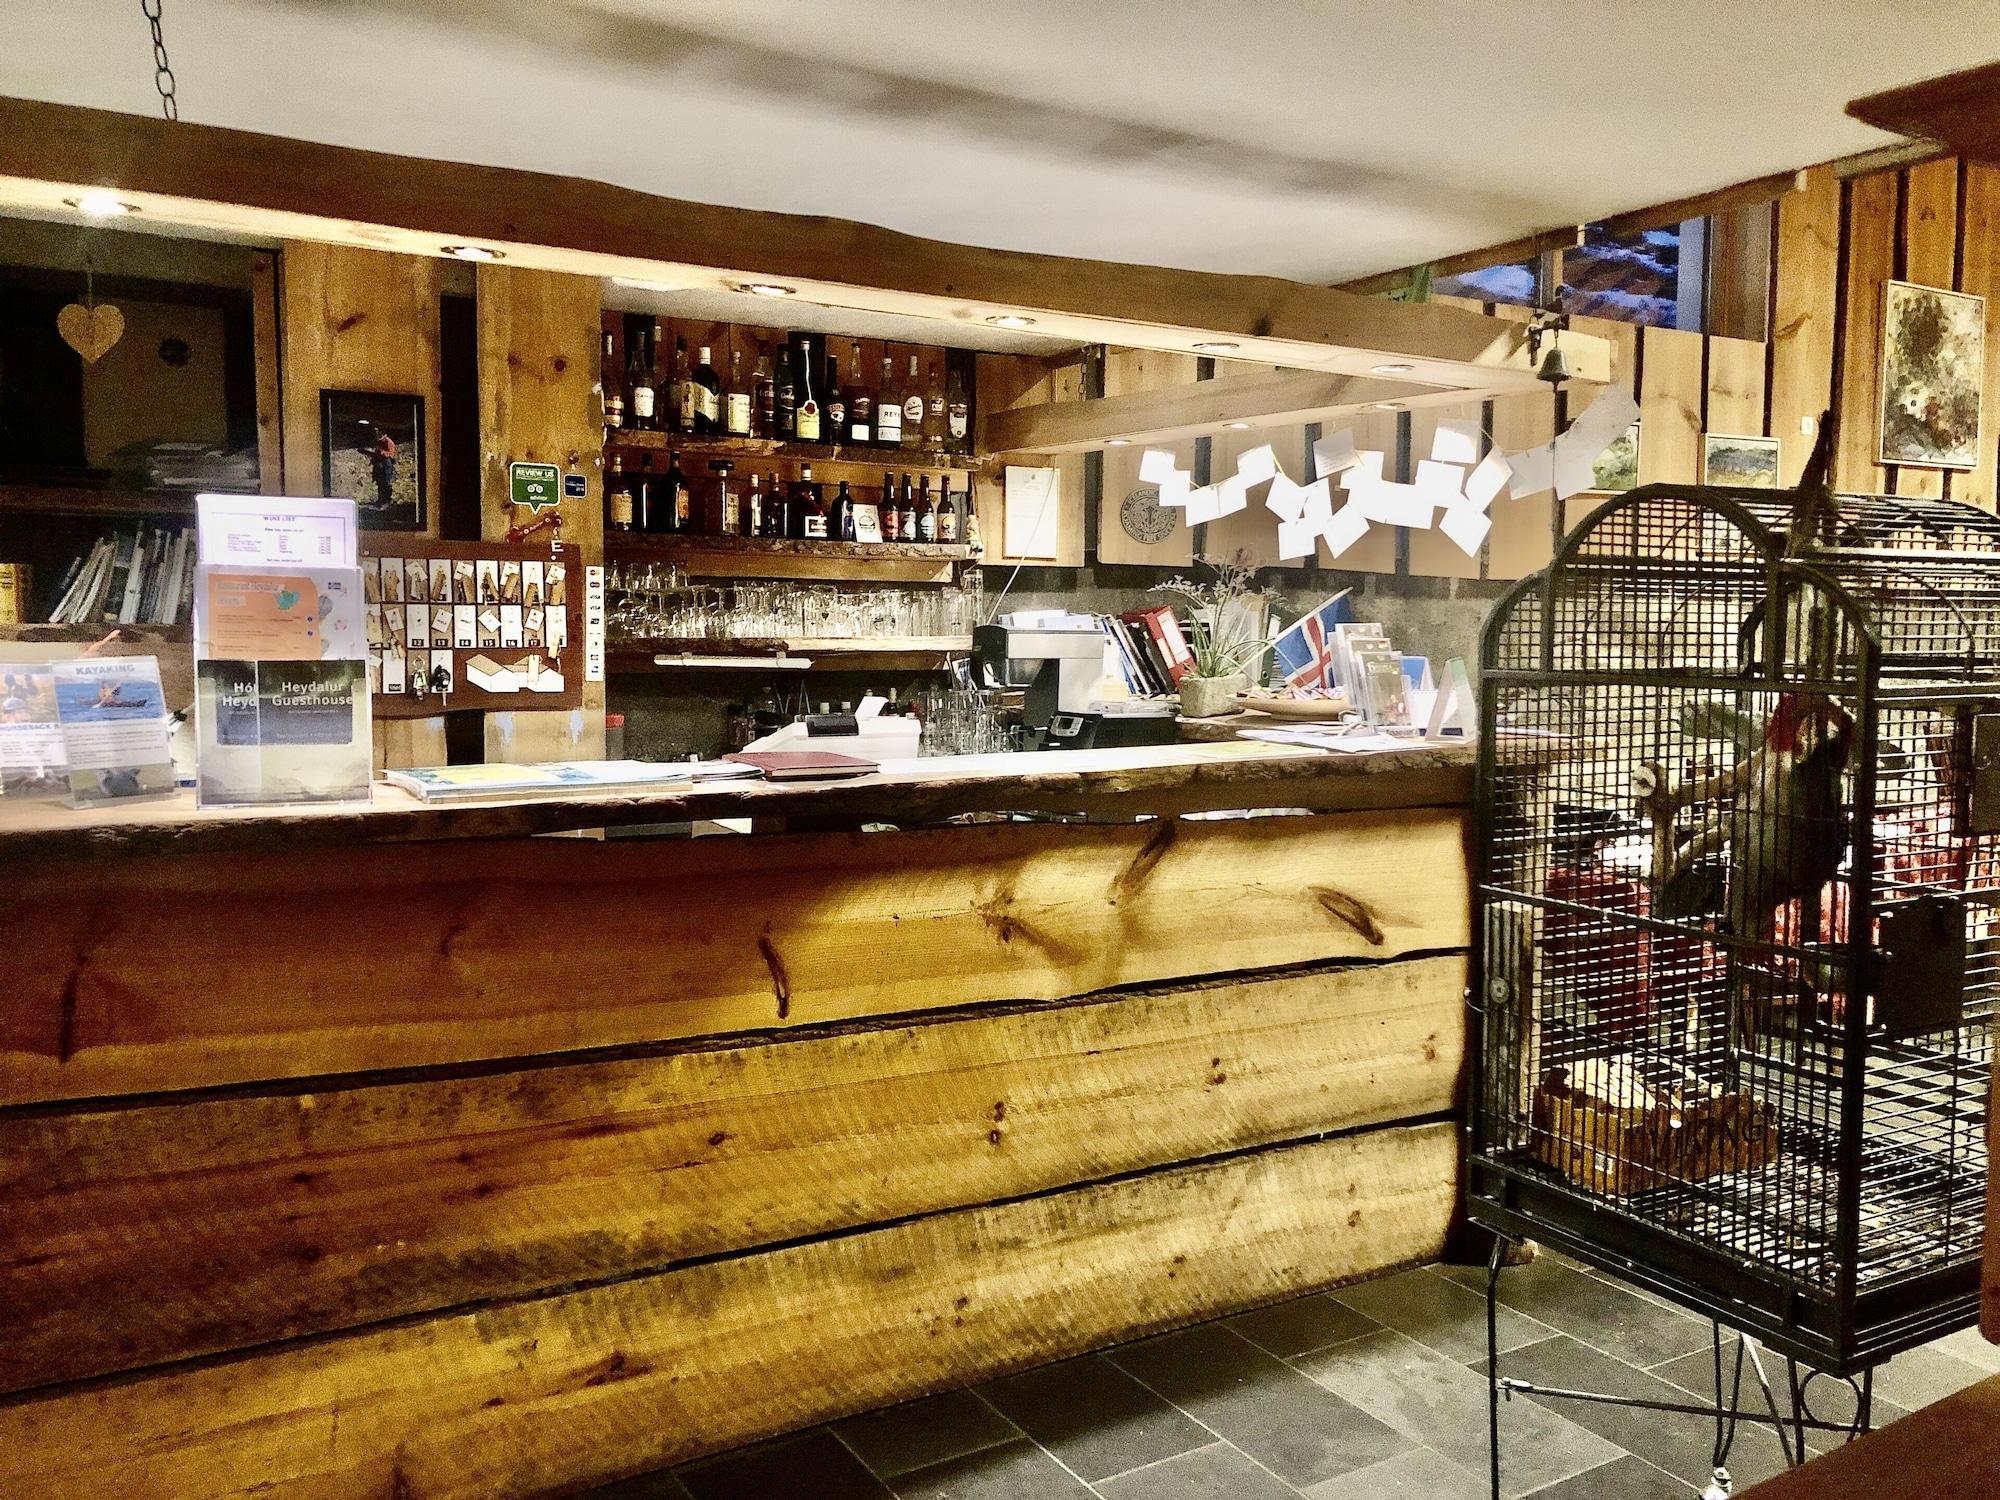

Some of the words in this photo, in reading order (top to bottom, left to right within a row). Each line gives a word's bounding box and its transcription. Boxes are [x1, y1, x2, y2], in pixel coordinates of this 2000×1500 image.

[516, 469, 543, 477] REVIEW
[545, 470, 554, 478] US
[551, 540, 564, 552] E
[76, 664, 135, 675] KAYAKING
[282, 681, 343, 694] Heydalur
[272, 695, 353, 707] Guesthouse
